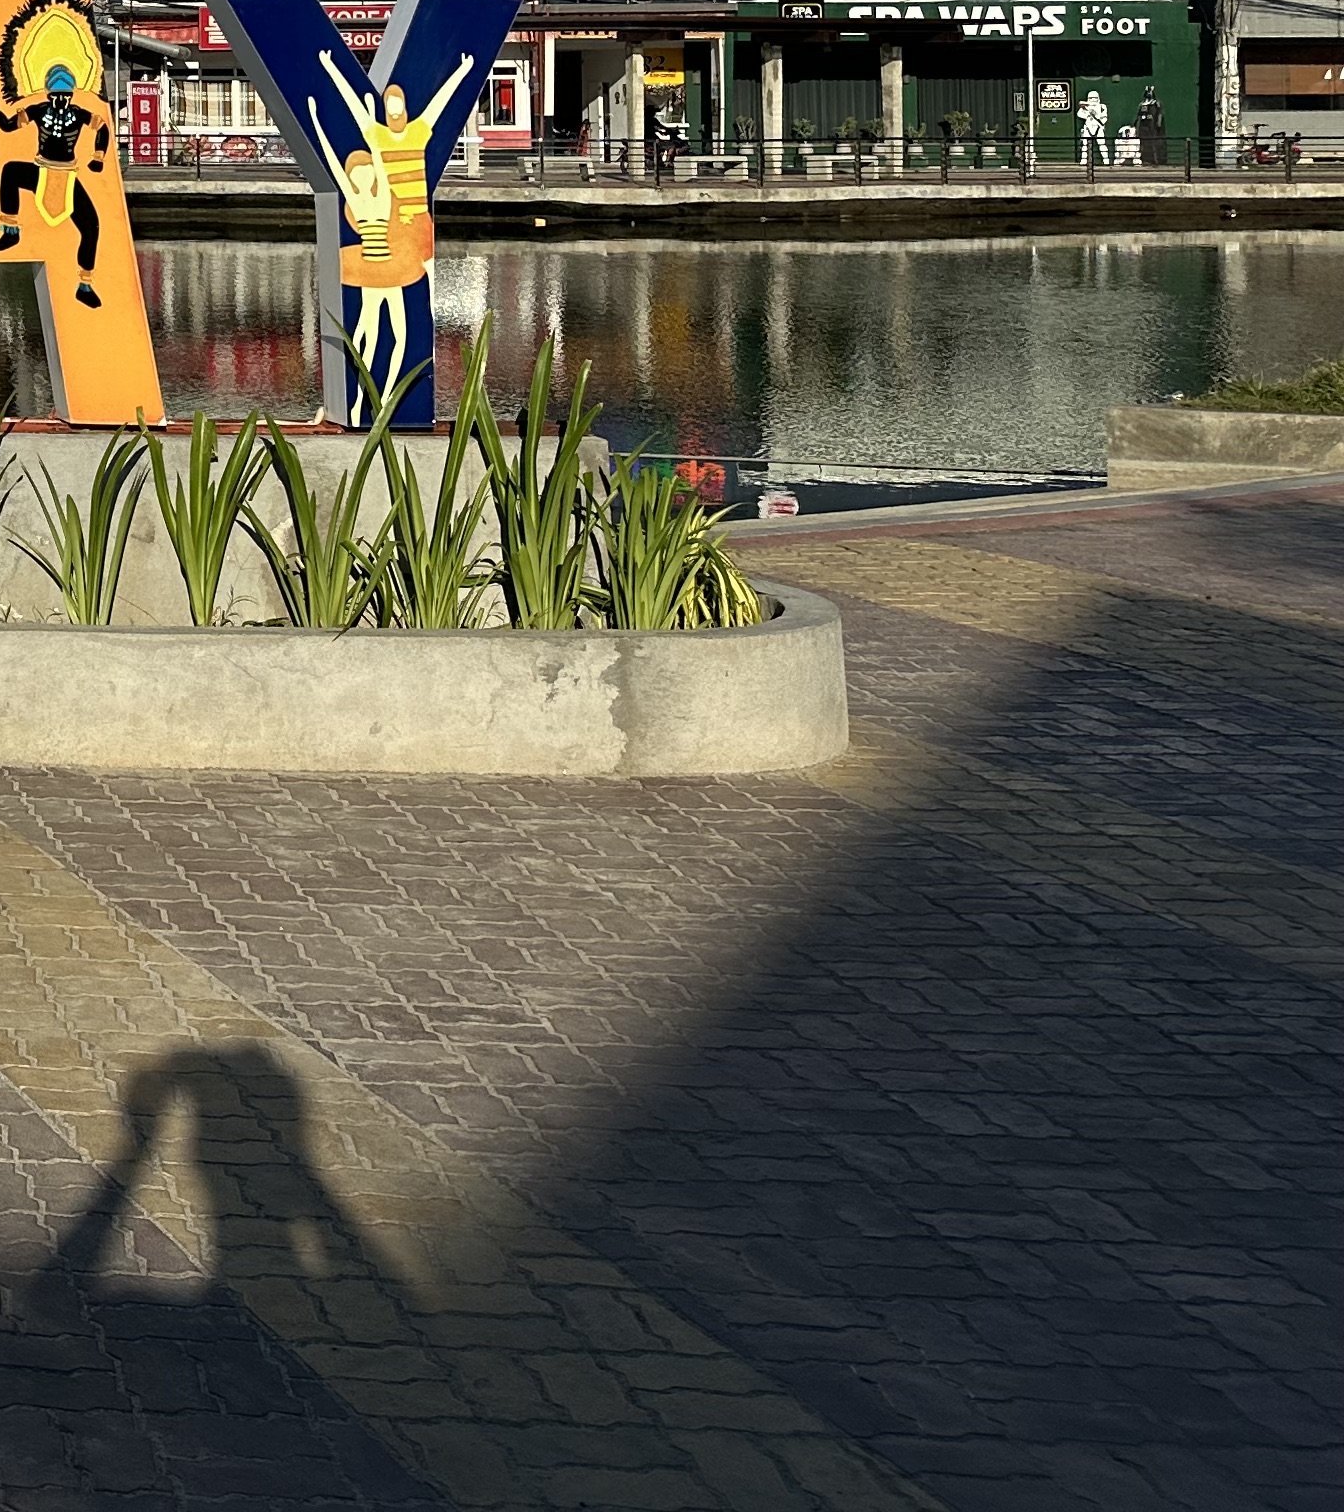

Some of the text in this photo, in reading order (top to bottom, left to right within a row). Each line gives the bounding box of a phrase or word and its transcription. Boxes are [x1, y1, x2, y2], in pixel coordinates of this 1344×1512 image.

[791, 6, 813, 16] SPA
[1080, 5, 1113, 14] SPA
[1080, 17, 1151, 35] FOOT
[1040, 100, 1068, 108] FOOT
